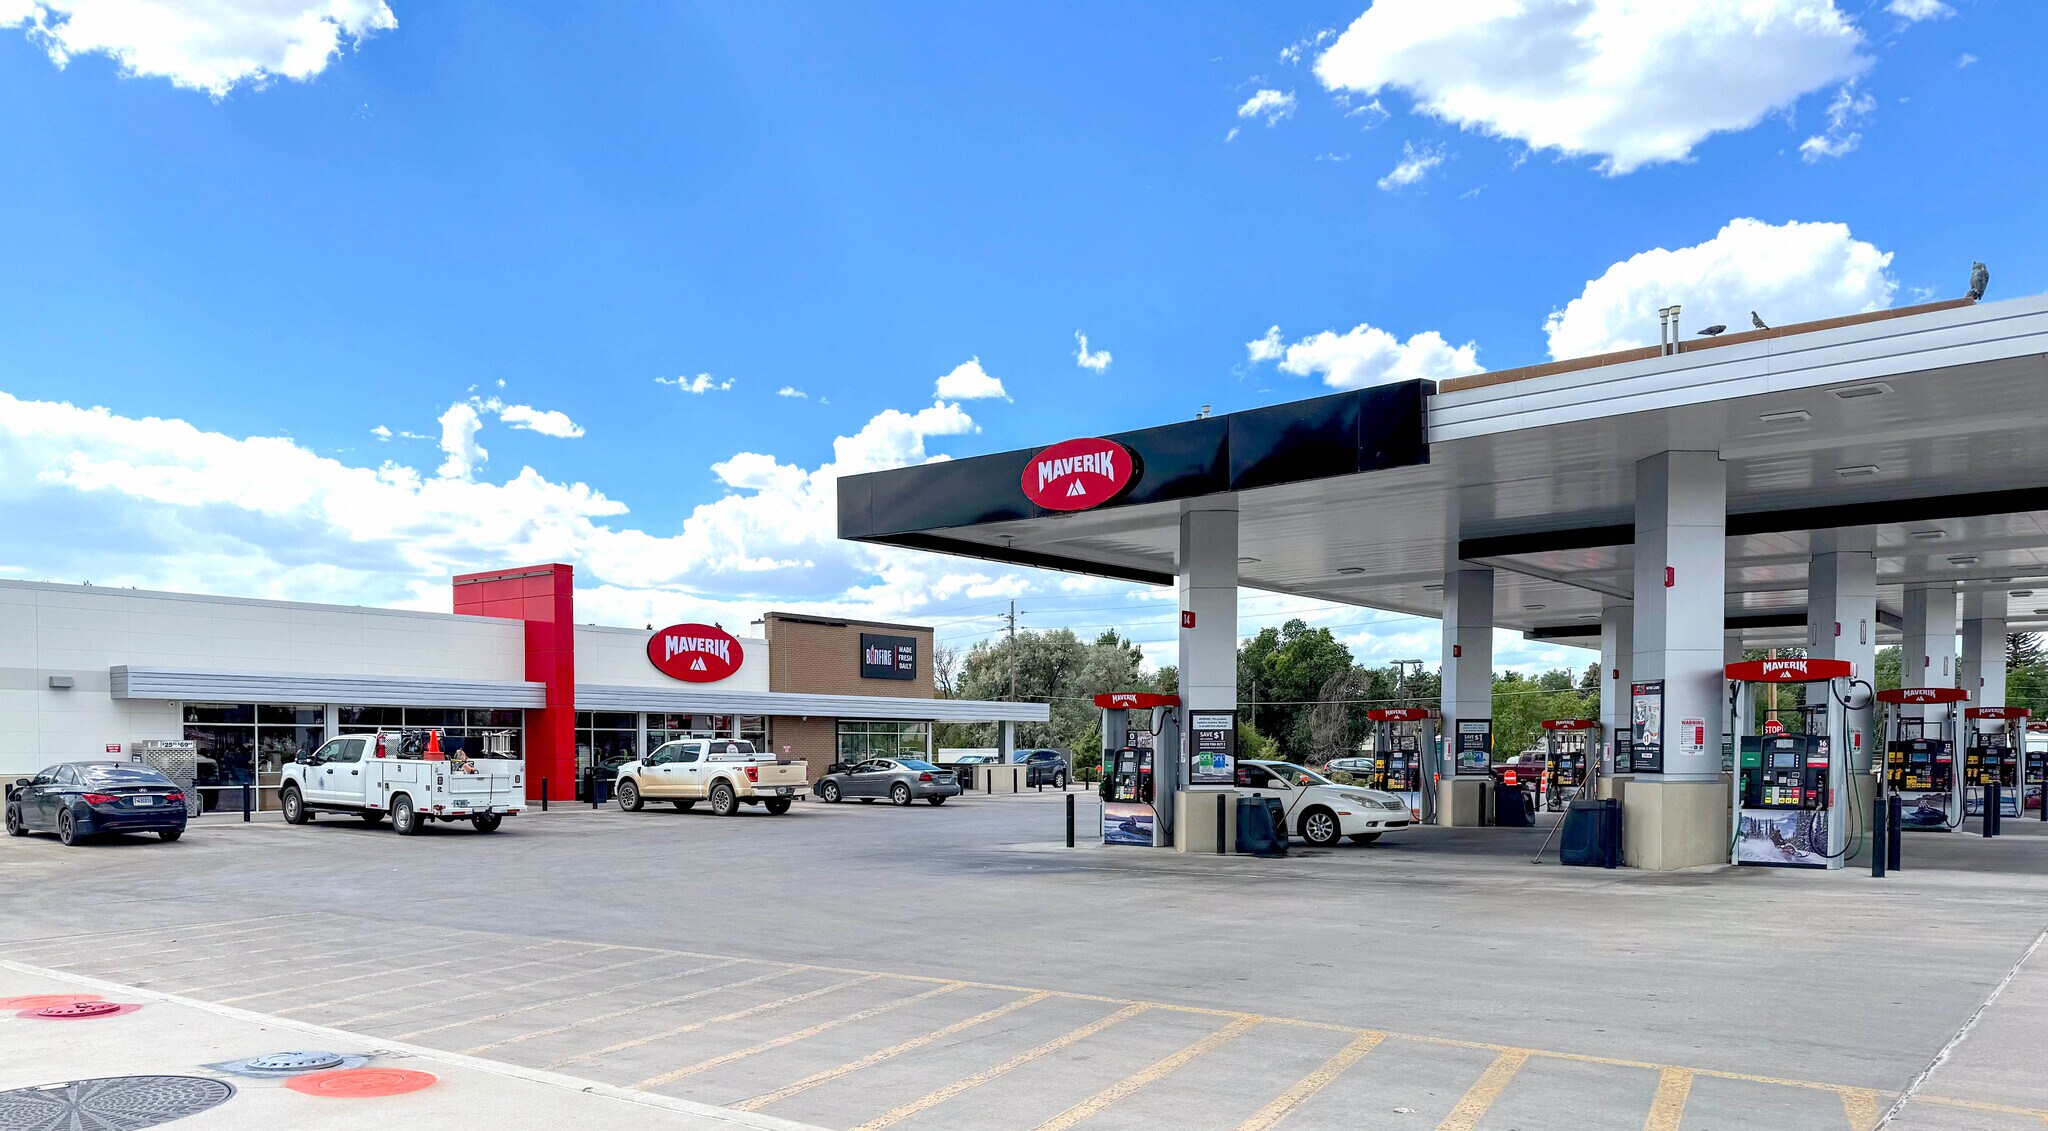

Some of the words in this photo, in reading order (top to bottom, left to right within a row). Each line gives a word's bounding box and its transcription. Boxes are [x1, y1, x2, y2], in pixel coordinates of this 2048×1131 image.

[1038, 449, 1114, 493] MAVERIK
[1184, 613, 1190, 624] 14
[665, 635, 730, 666] MAVERIK
[1762, 661, 1808, 675] MAVERIK
[1112, 694, 1138, 704] MAVERIK
[1903, 689, 1936, 699] MAVERIK
[1385, 709, 1408, 717] MAVERIK
[1764, 725, 1782, 733] STOP
[1213, 730, 1224, 740] $1
